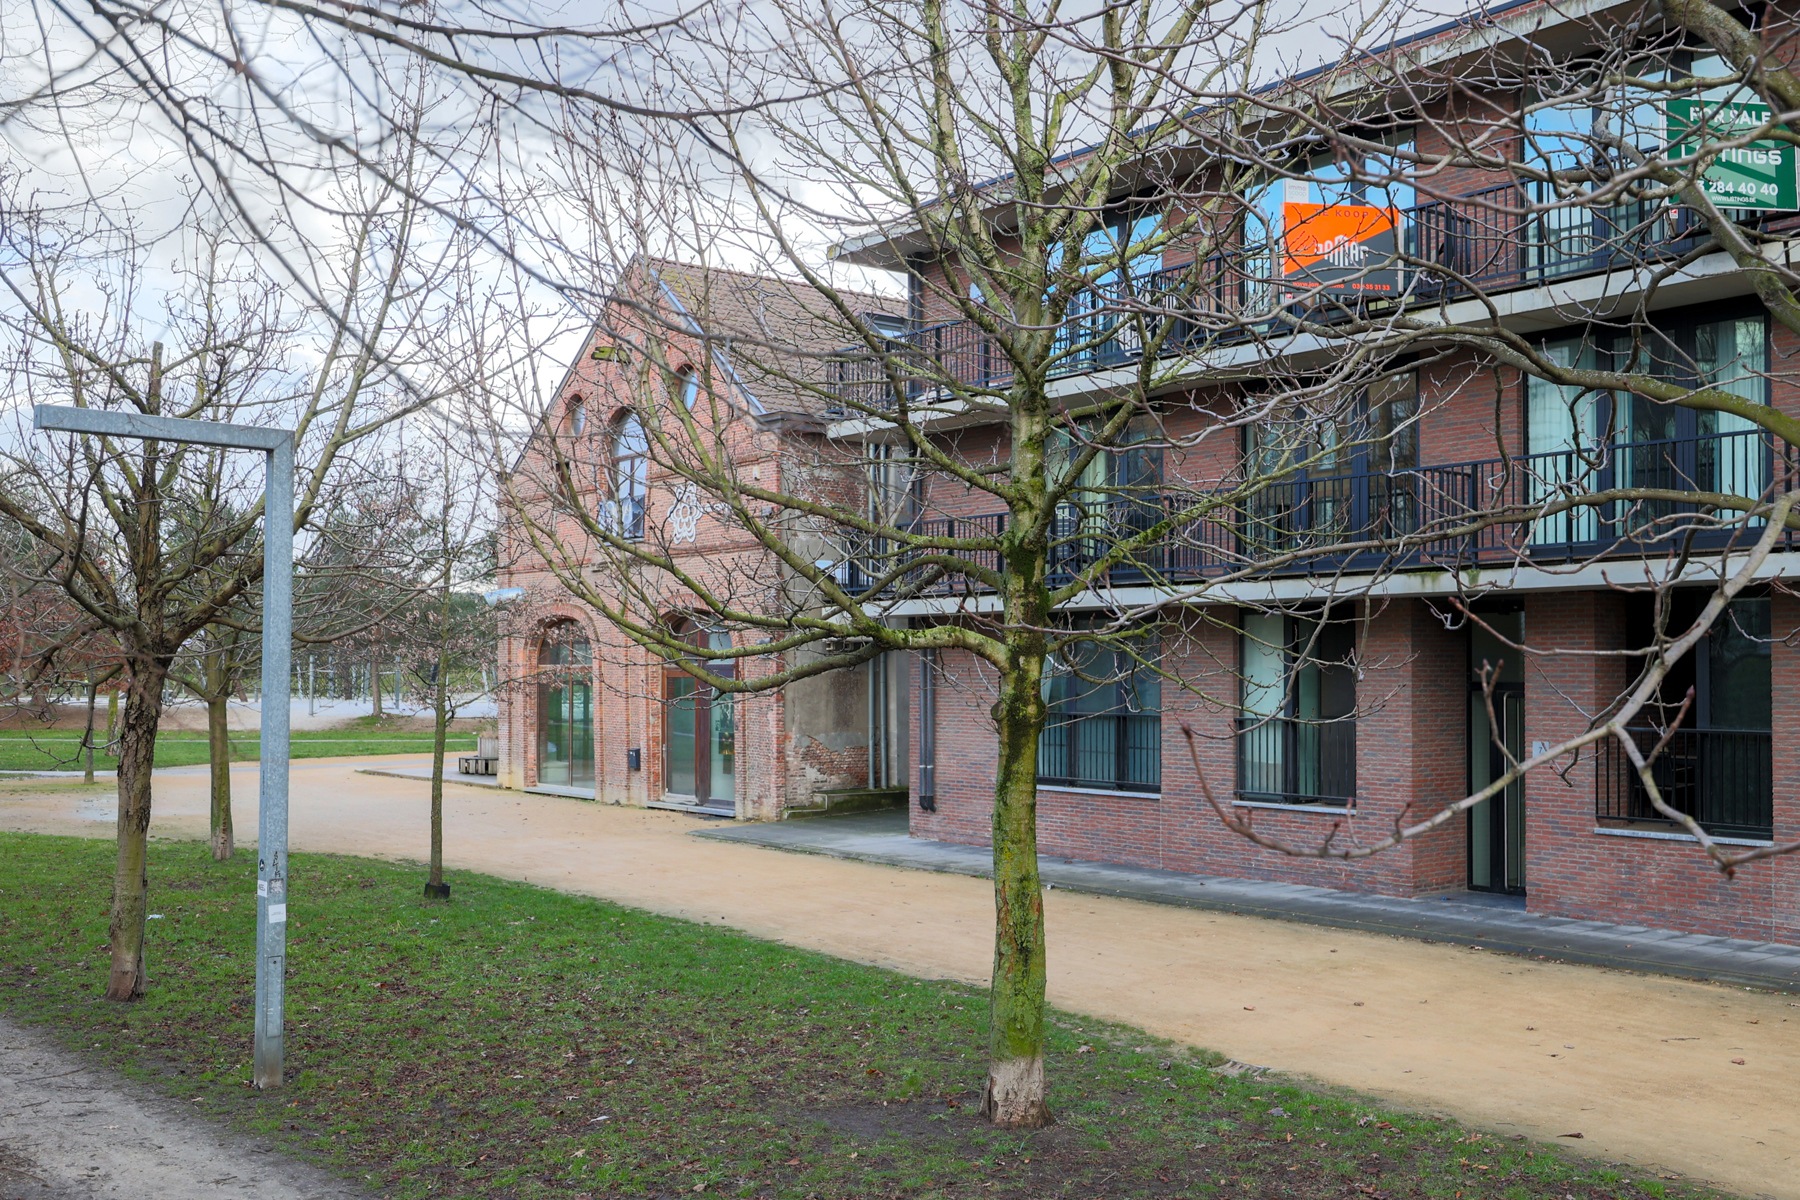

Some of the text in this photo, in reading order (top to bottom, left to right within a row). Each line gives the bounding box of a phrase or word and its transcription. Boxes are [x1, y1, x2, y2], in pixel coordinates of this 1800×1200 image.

[1689, 107, 1771, 126] FOR SALE
[1709, 181, 1734, 194] 284
[1738, 182, 1757, 195] 40
[1760, 183, 1779, 196] 40
[1335, 209, 1369, 218] KOOP
